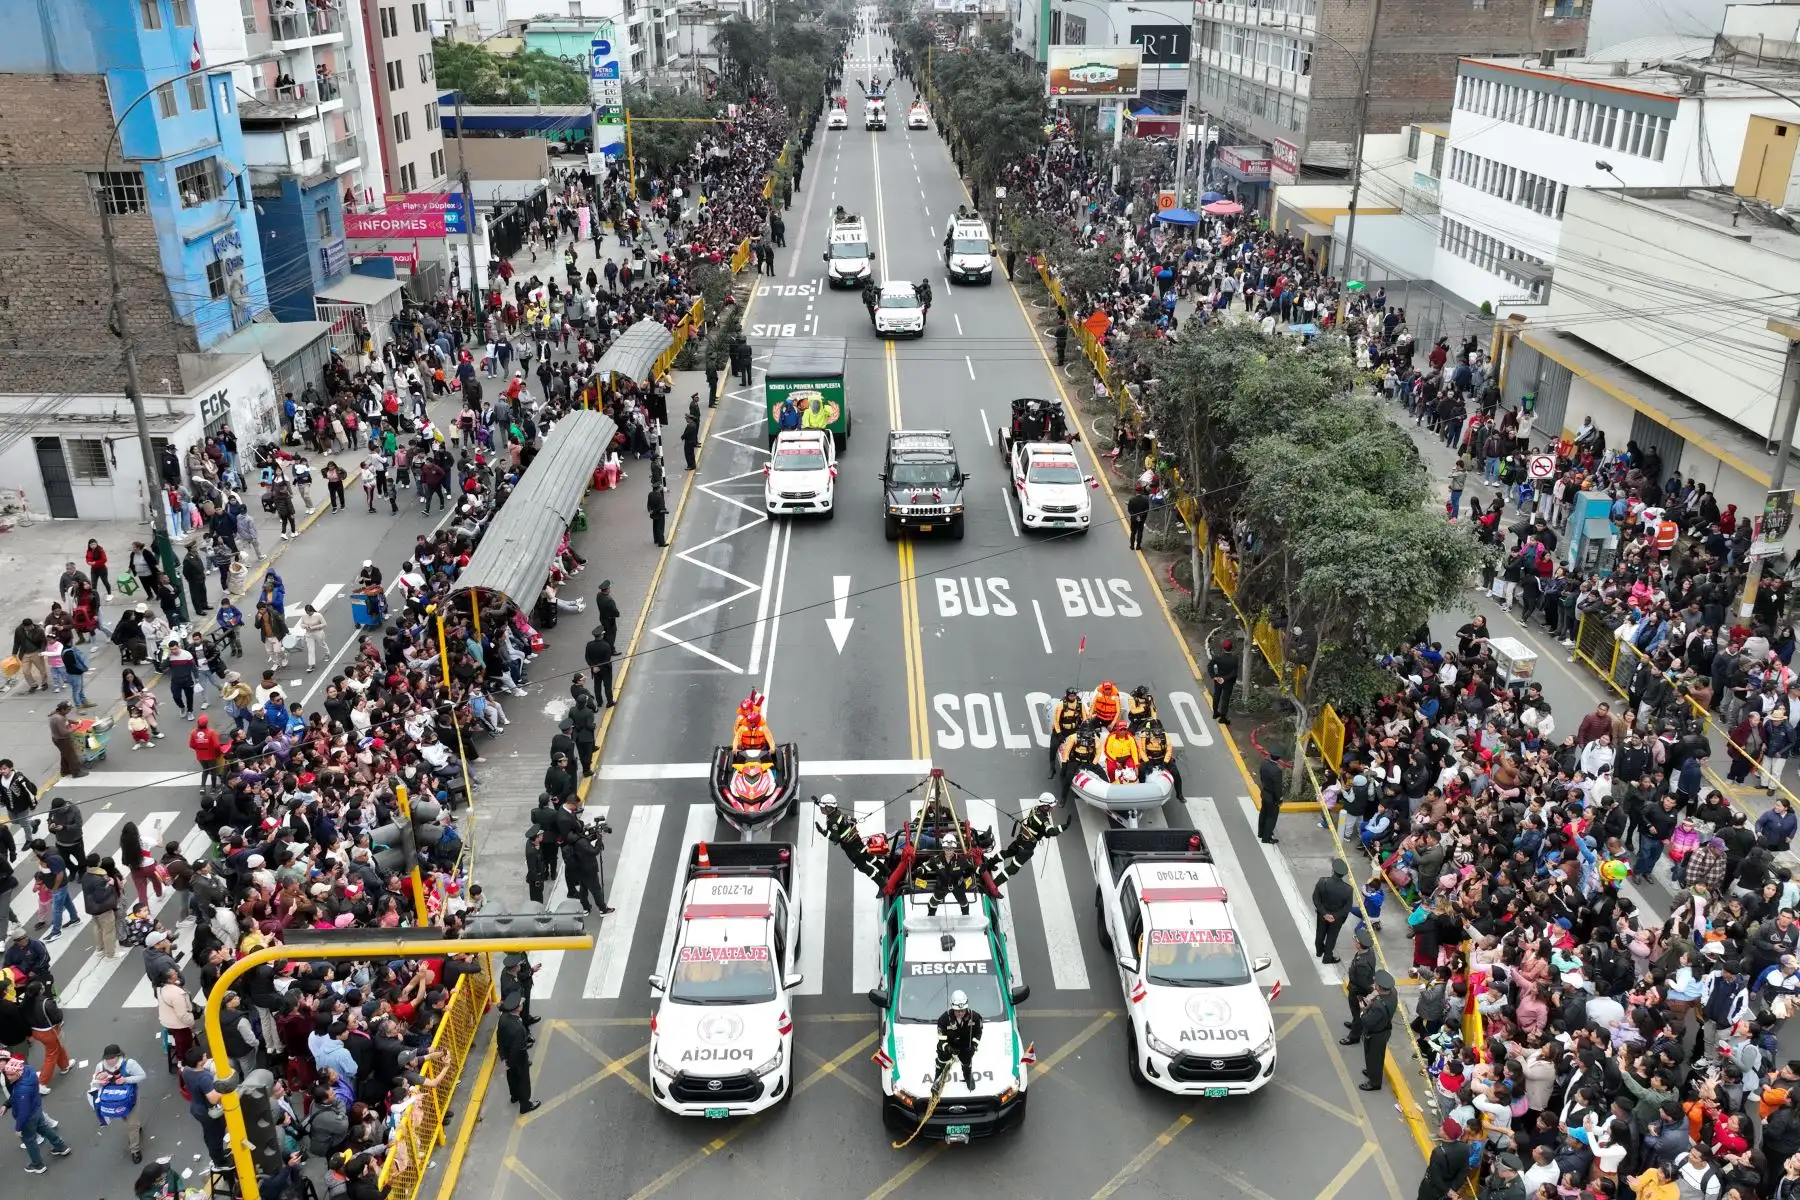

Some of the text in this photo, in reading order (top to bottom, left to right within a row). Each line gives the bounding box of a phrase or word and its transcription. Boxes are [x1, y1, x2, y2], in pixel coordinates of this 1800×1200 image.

[358, 219, 428, 230] INFORMES
[834, 233, 862, 242] SUAT
[957, 229, 984, 238] SUAT
[757, 285, 811, 297] SOLO
[750, 323, 797, 337] BUS
[935, 576, 1018, 618] BUS
[1055, 577, 1143, 618] BUS
[1156, 870, 1199, 881] PL-27040
[711, 884, 754, 896] PL-27038
[1151, 929, 1235, 945] SALVATAJE
[680, 946, 769, 962] SALVATAJE
[911, 962, 988, 976] RESCATE
